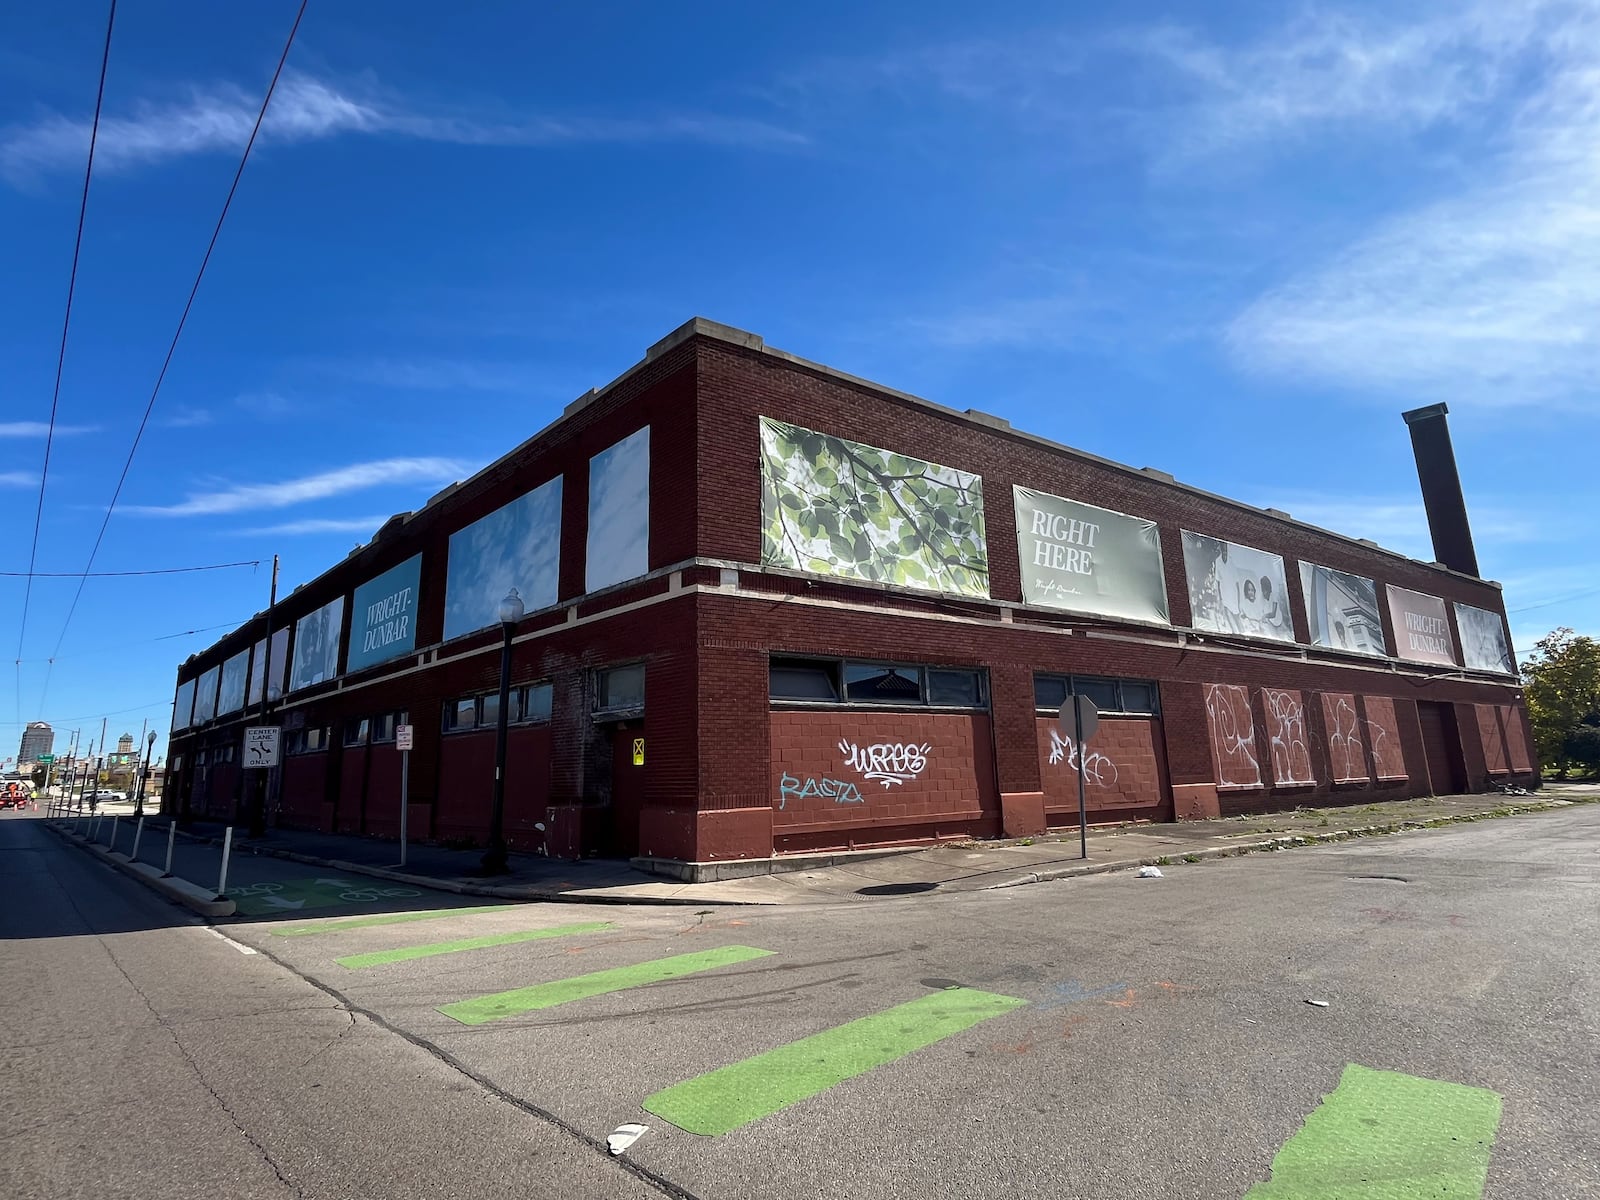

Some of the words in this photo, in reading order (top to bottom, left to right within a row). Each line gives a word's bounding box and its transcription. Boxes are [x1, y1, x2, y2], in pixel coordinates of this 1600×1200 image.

[1030, 508, 1100, 548] RIGHT
[1032, 539, 1093, 576] HERE
[366, 587, 412, 628] WRIGHT-
[1404, 611, 1446, 635] WRIGHT-
[363, 615, 409, 653] DUNBAR
[1408, 632, 1449, 655] DUNBAR
[779, 771, 865, 811] RASTA
